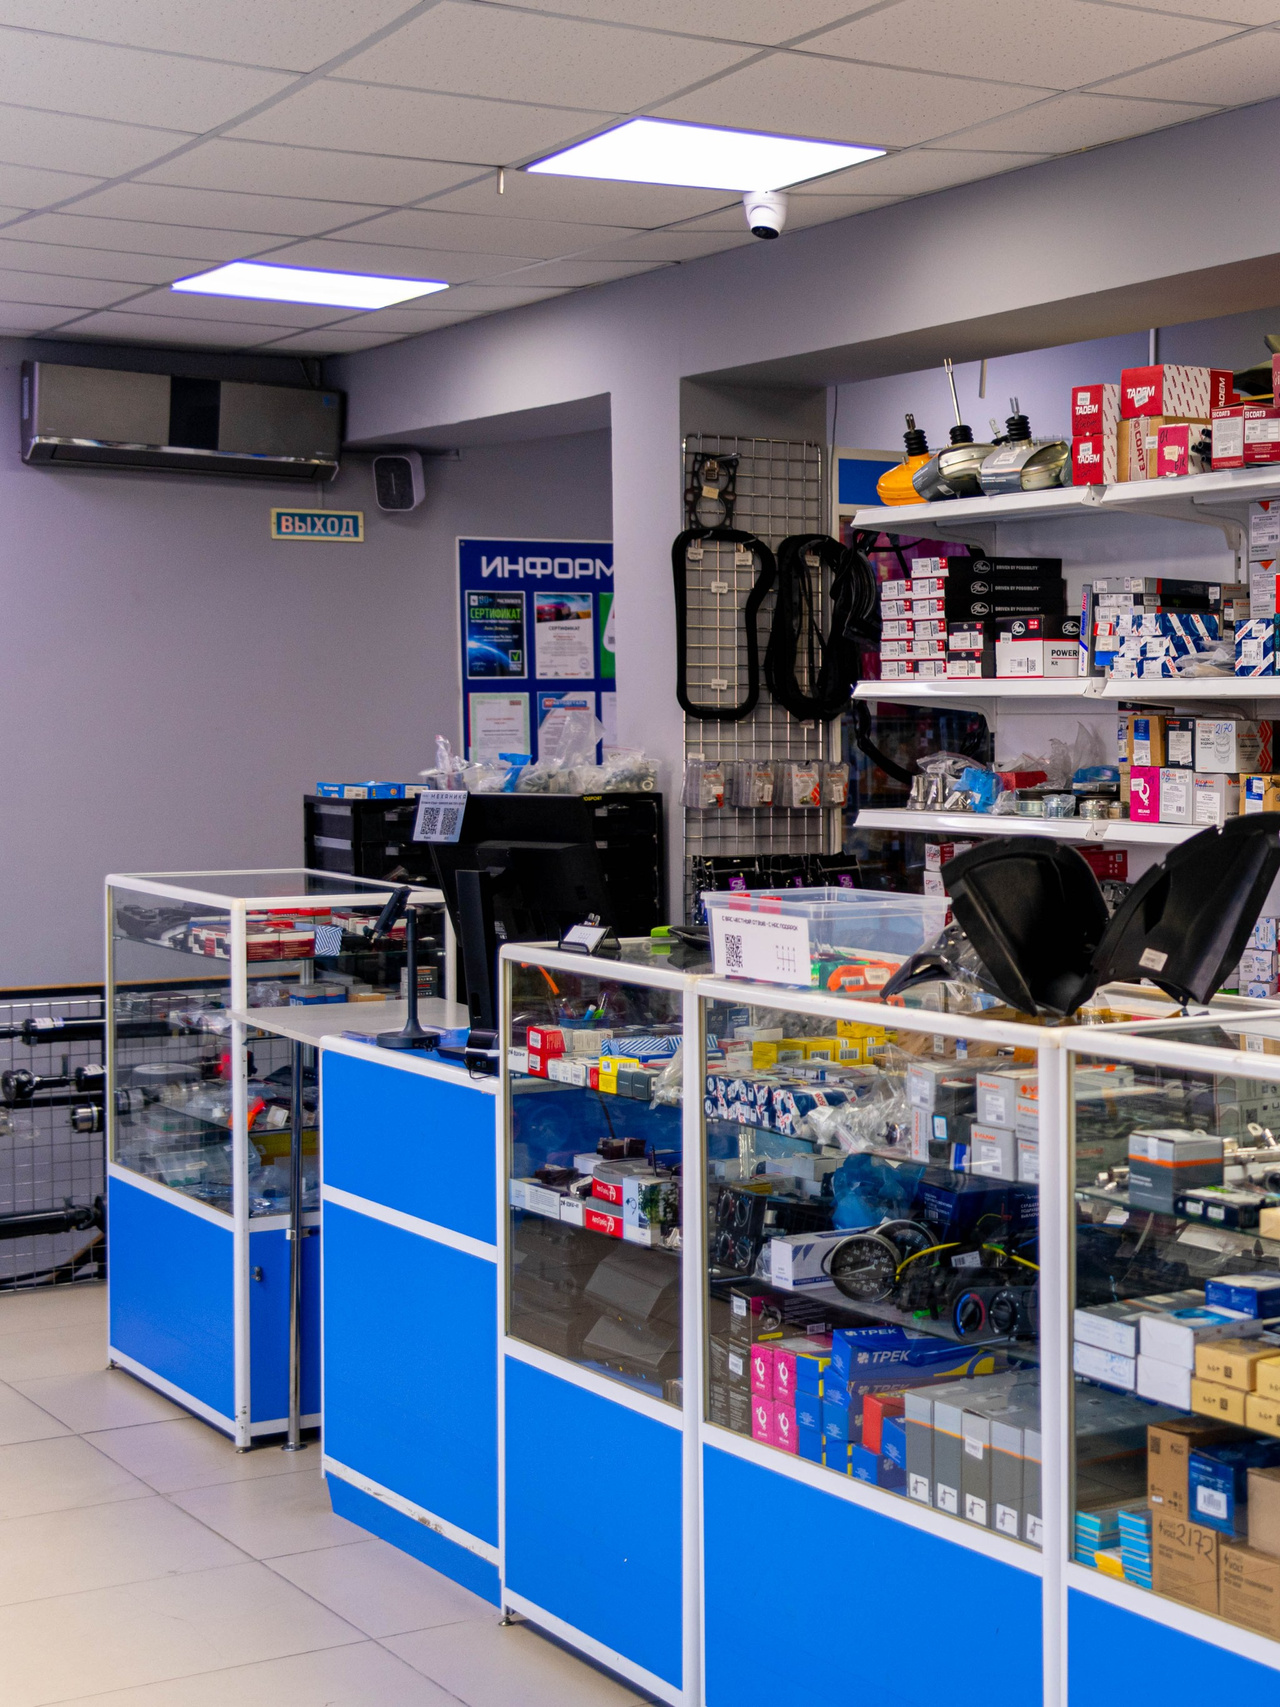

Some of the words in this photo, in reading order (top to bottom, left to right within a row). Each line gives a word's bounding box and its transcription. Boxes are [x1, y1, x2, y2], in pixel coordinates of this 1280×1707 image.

[1126, 386, 1156, 401] TADEM
[1076, 404, 1099, 415] TADEM
[1077, 454, 1100, 465] TADEM
[281, 515, 355, 536] ВЫХОД
[481, 556, 614, 580] ИНФОРМ
[470, 608, 521, 619] СЕРТИФИКАТ
[1215, 723, 1233, 735] 2170
[861, 1328, 897, 1336] ТРЕК
[872, 1350, 911, 1363] ТРЕК
[1176, 1523, 1216, 1565] 2172
[1229, 1560, 1244, 1574] VOLT
